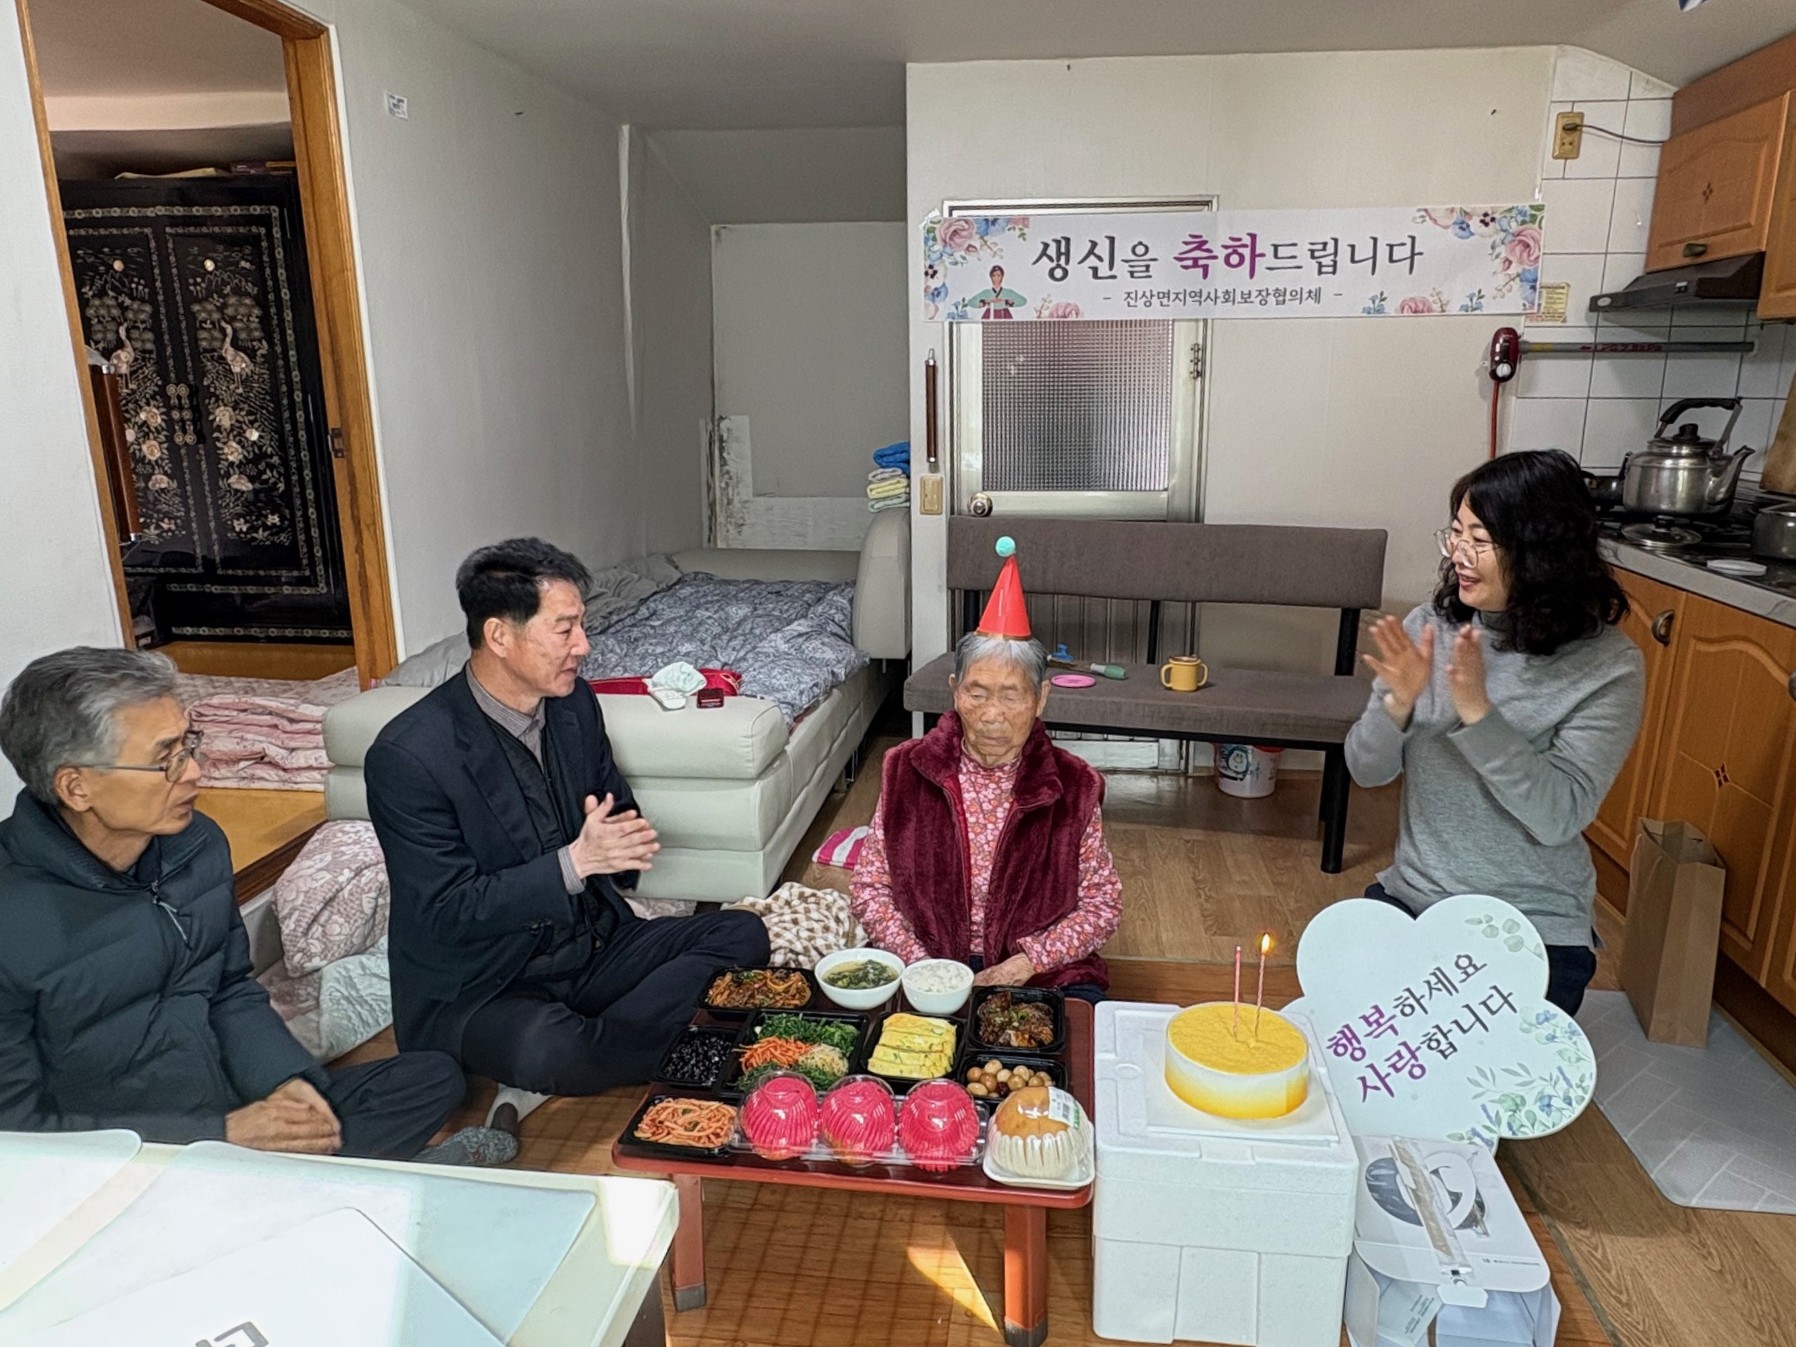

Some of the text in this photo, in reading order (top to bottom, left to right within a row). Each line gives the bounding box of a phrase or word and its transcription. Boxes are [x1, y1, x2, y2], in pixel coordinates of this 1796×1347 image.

[1032, 232, 1424, 282] 생신을 축하드립니다
[1123, 286, 1322, 308] 진상면지역사회보장협의체
[1326, 953, 1488, 1063] 행복하세요
[1356, 984, 1518, 1103] 사랑합니다
